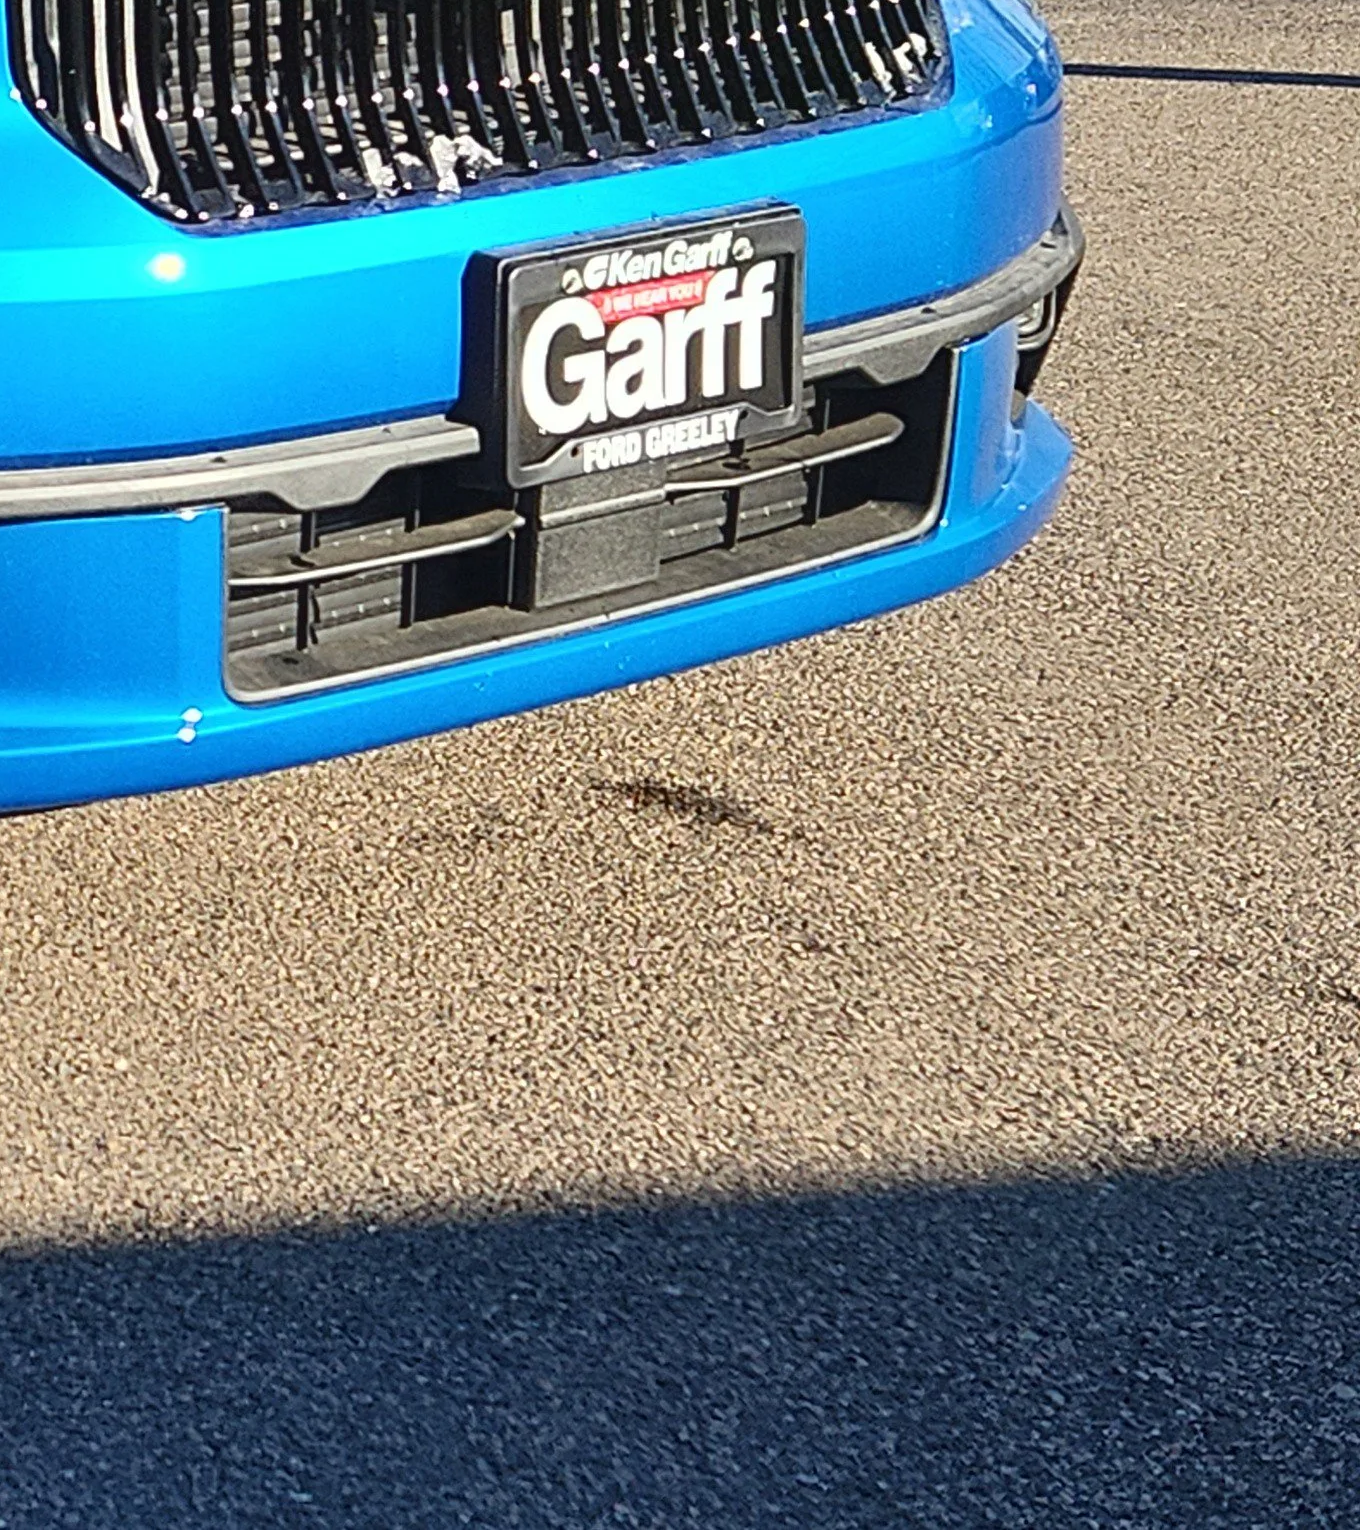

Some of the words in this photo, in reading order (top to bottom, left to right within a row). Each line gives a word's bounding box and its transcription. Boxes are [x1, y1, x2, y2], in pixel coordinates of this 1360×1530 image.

[607, 249, 663, 287] Ken
[662, 230, 734, 276] Garff
[521, 259, 777, 435] Garff
[583, 432, 642, 473] FORD
[645, 408, 741, 459] GREELEY
